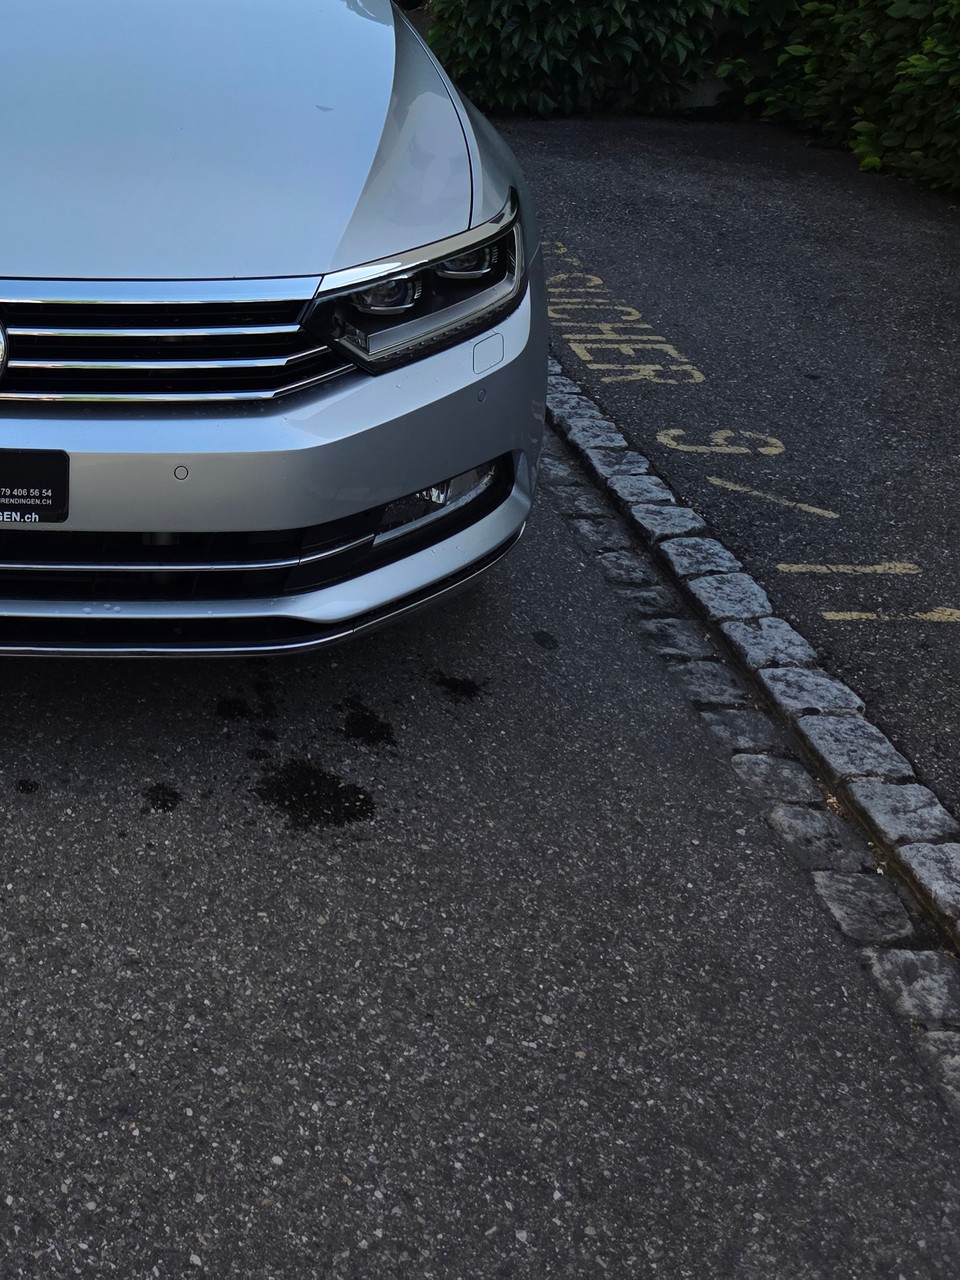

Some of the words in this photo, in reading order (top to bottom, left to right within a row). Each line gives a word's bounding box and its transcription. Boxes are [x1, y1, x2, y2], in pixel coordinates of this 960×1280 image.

[12, 488, 28, 496] 406
[29, 489, 40, 497] 56
[41, 489, 52, 497] 54
